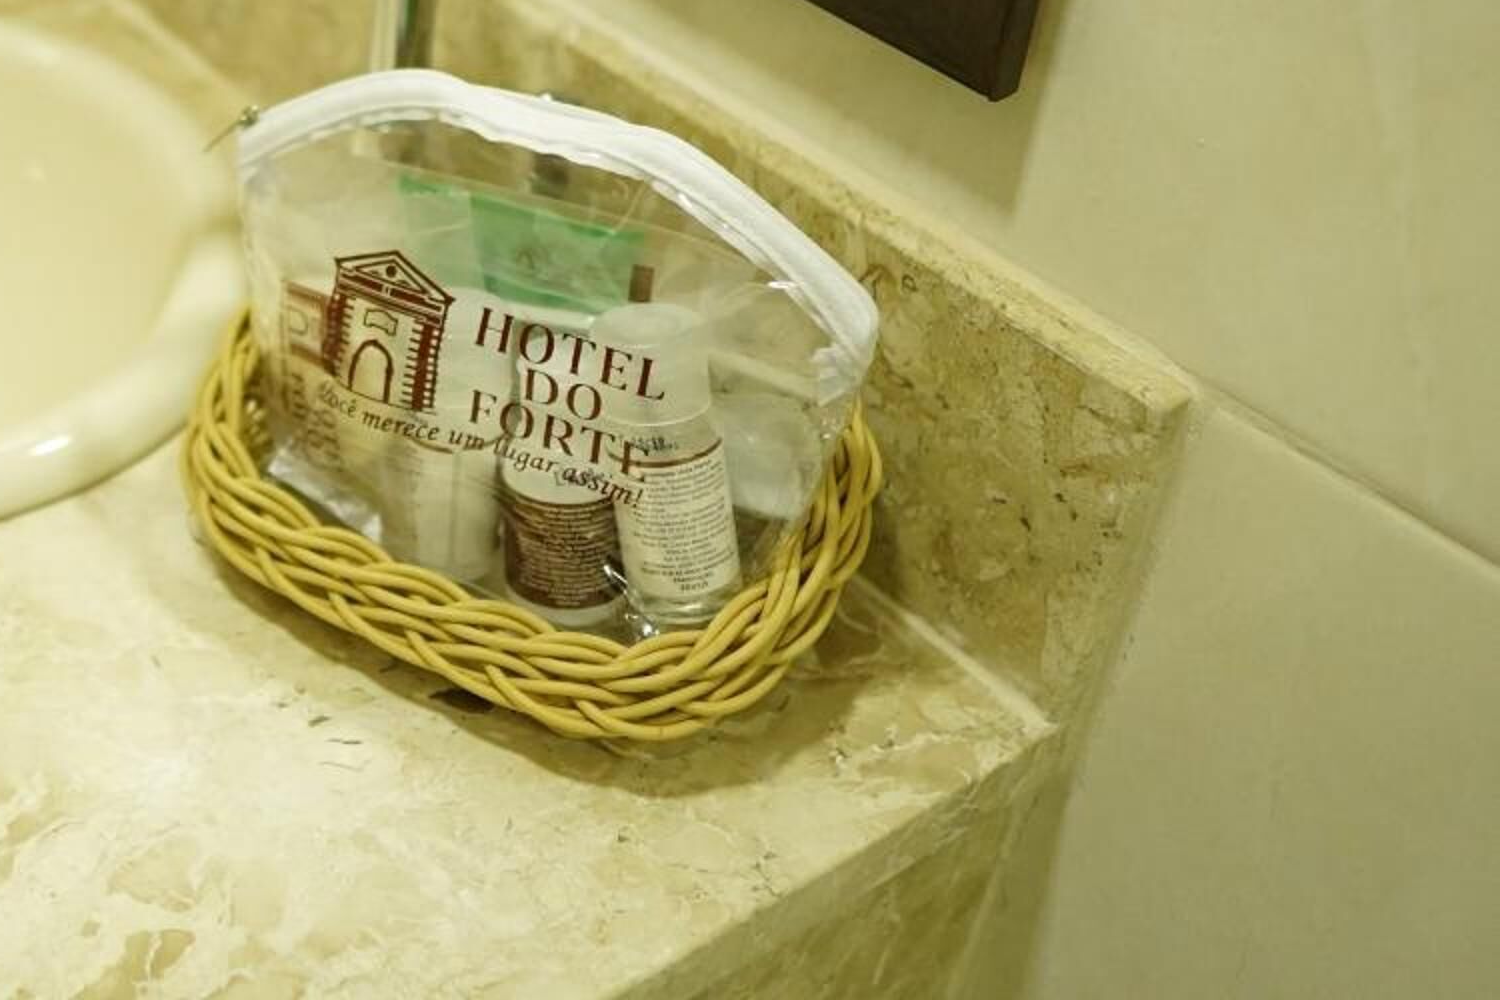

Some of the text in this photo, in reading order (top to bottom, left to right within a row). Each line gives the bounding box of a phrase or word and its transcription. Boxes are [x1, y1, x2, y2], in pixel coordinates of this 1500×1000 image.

[475, 307, 665, 400] HOTEL
[524, 367, 603, 420] DO
[361, 411, 440, 440] merece
[449, 430, 485, 451] um
[494, 437, 560, 471] lugar
[561, 466, 643, 508] assim!
[469, 389, 647, 482] FORTE
